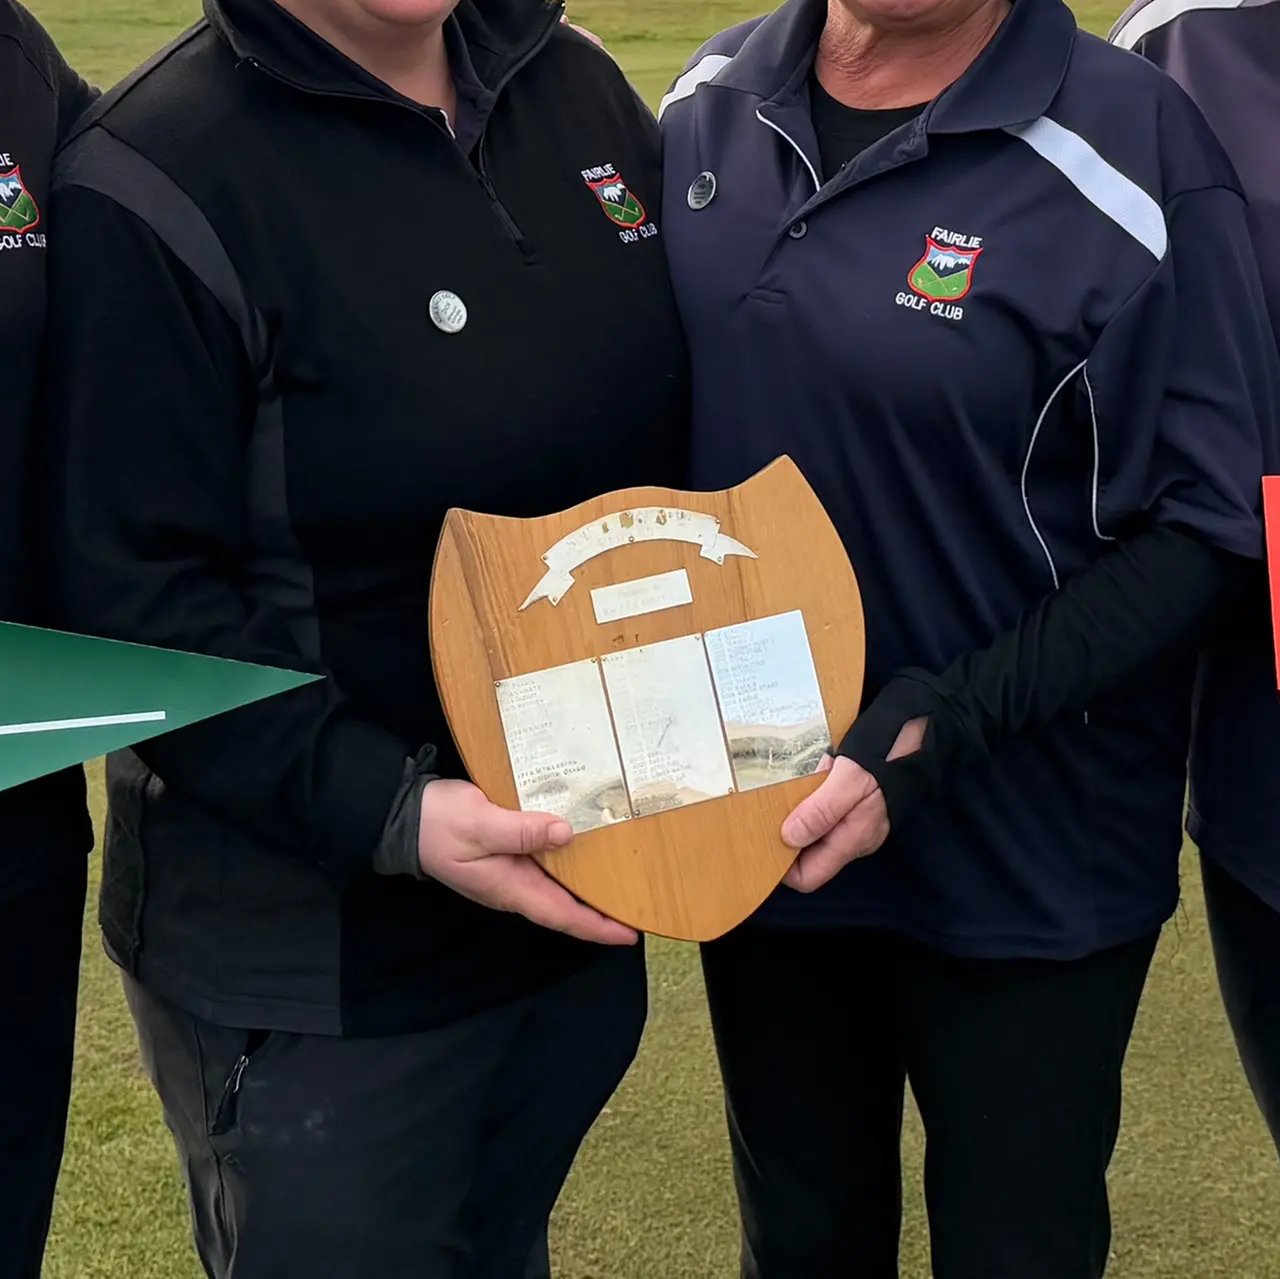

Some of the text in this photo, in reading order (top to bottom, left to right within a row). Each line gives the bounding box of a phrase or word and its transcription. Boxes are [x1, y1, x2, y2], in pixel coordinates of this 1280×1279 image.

[581, 163, 616, 182] FAIRLIE
[26, 233, 47, 248] CLUB
[619, 222, 658, 244] GOLF CLUB
[931, 226, 982, 248] FAIRLIE
[895, 292, 963, 320] GOLF CLUB
